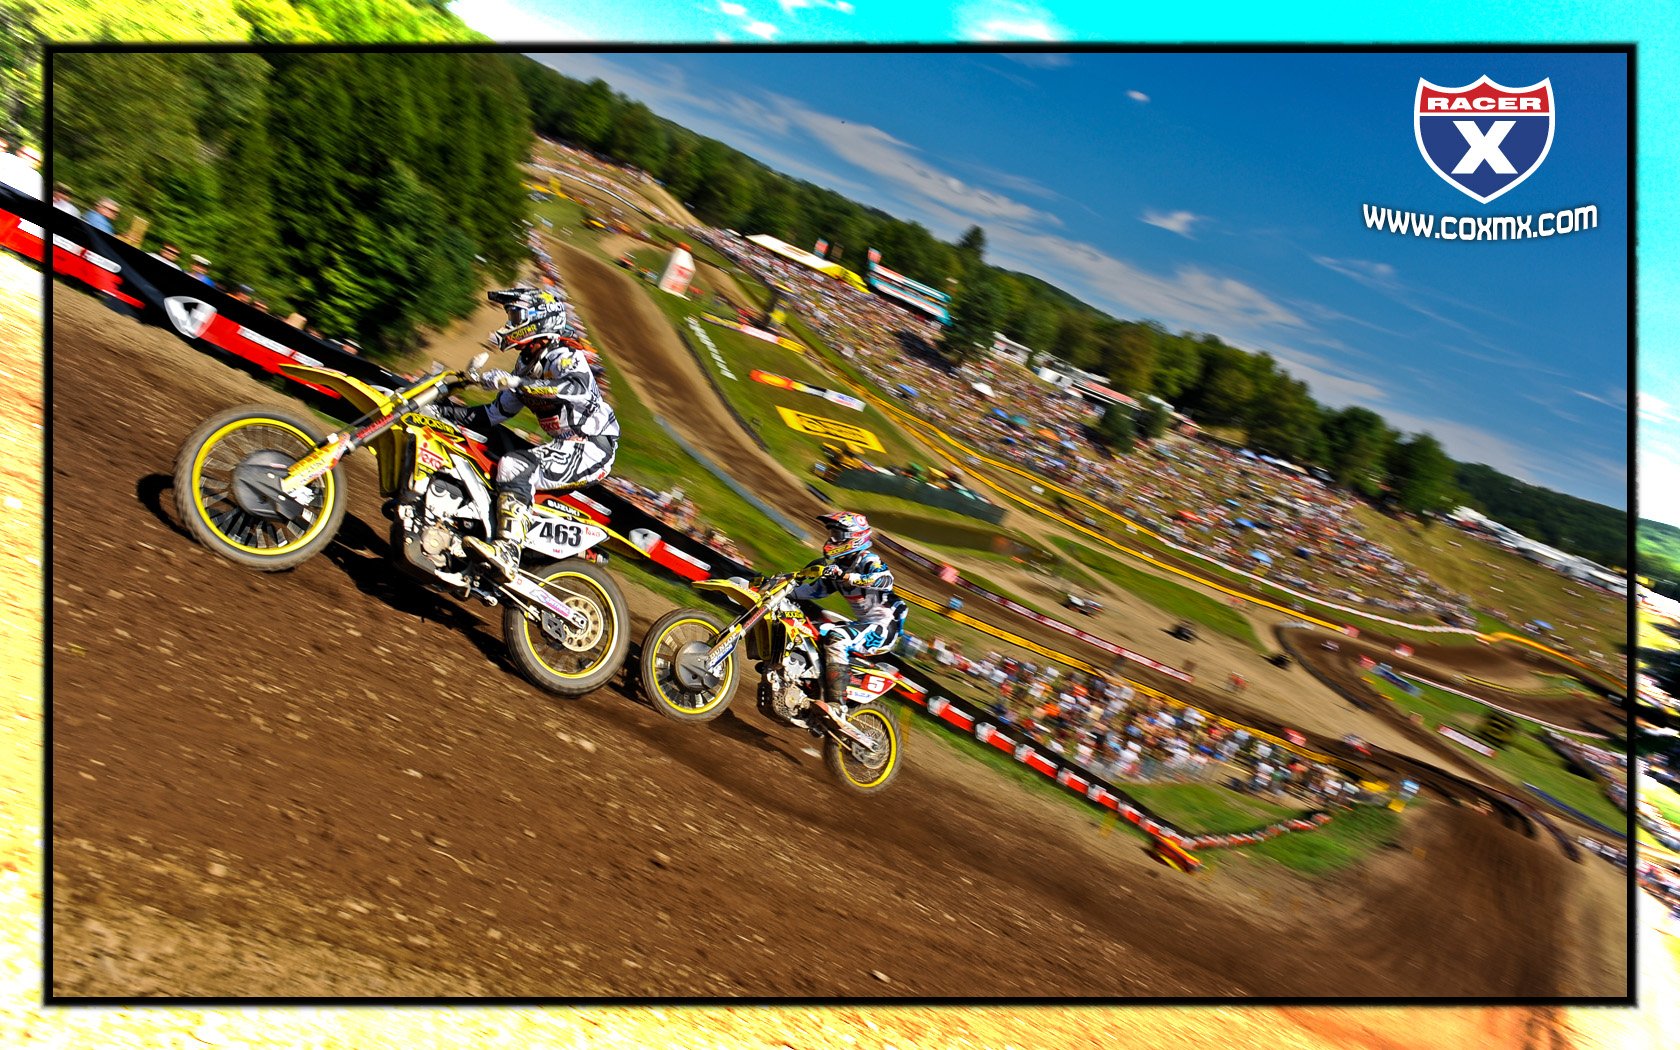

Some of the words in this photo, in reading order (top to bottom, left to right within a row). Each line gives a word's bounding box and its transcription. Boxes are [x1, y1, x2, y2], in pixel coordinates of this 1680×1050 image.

[547, 499, 581, 517] SUZUKI
[539, 522, 582, 547] 463
[867, 676, 886, 693] 5
